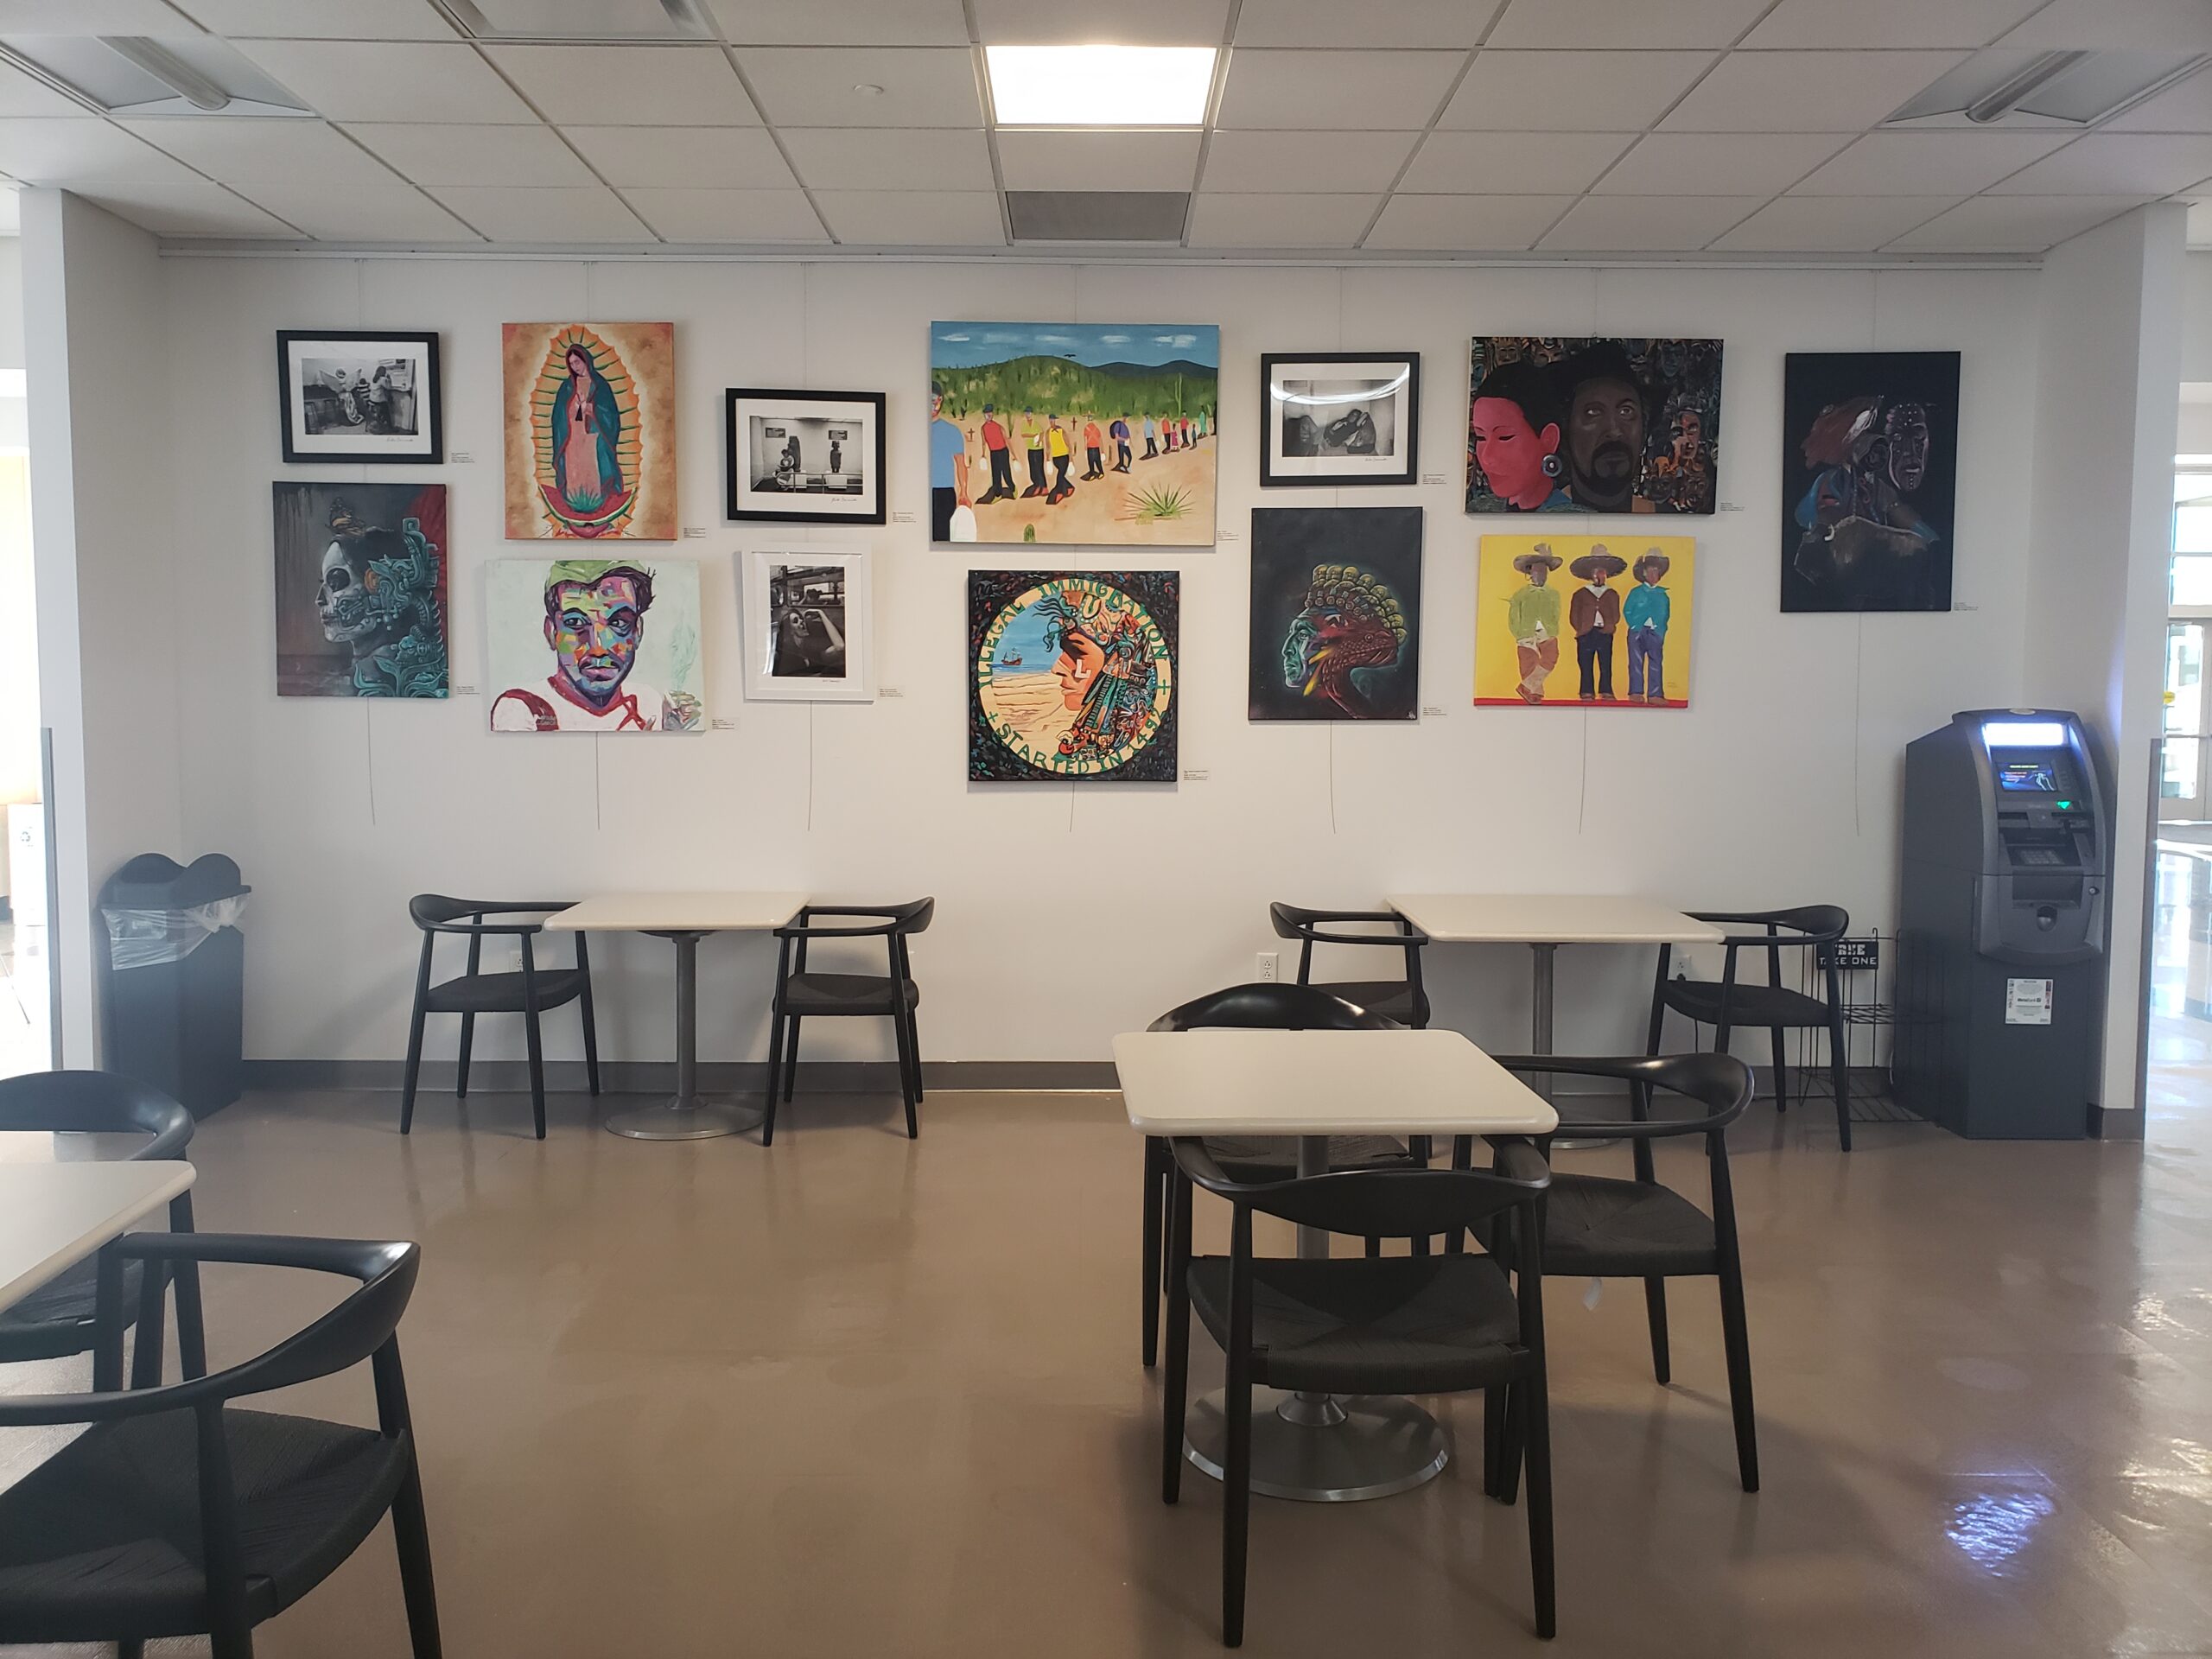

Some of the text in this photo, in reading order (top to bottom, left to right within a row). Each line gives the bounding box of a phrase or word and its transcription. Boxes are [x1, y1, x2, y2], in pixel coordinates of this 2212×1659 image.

[978, 578, 1169, 690] ILLEGAL IMMIGRATION
[995, 706, 1166, 774] STARTED IN 1492
[1819, 957, 1877, 965] TKE ONE
